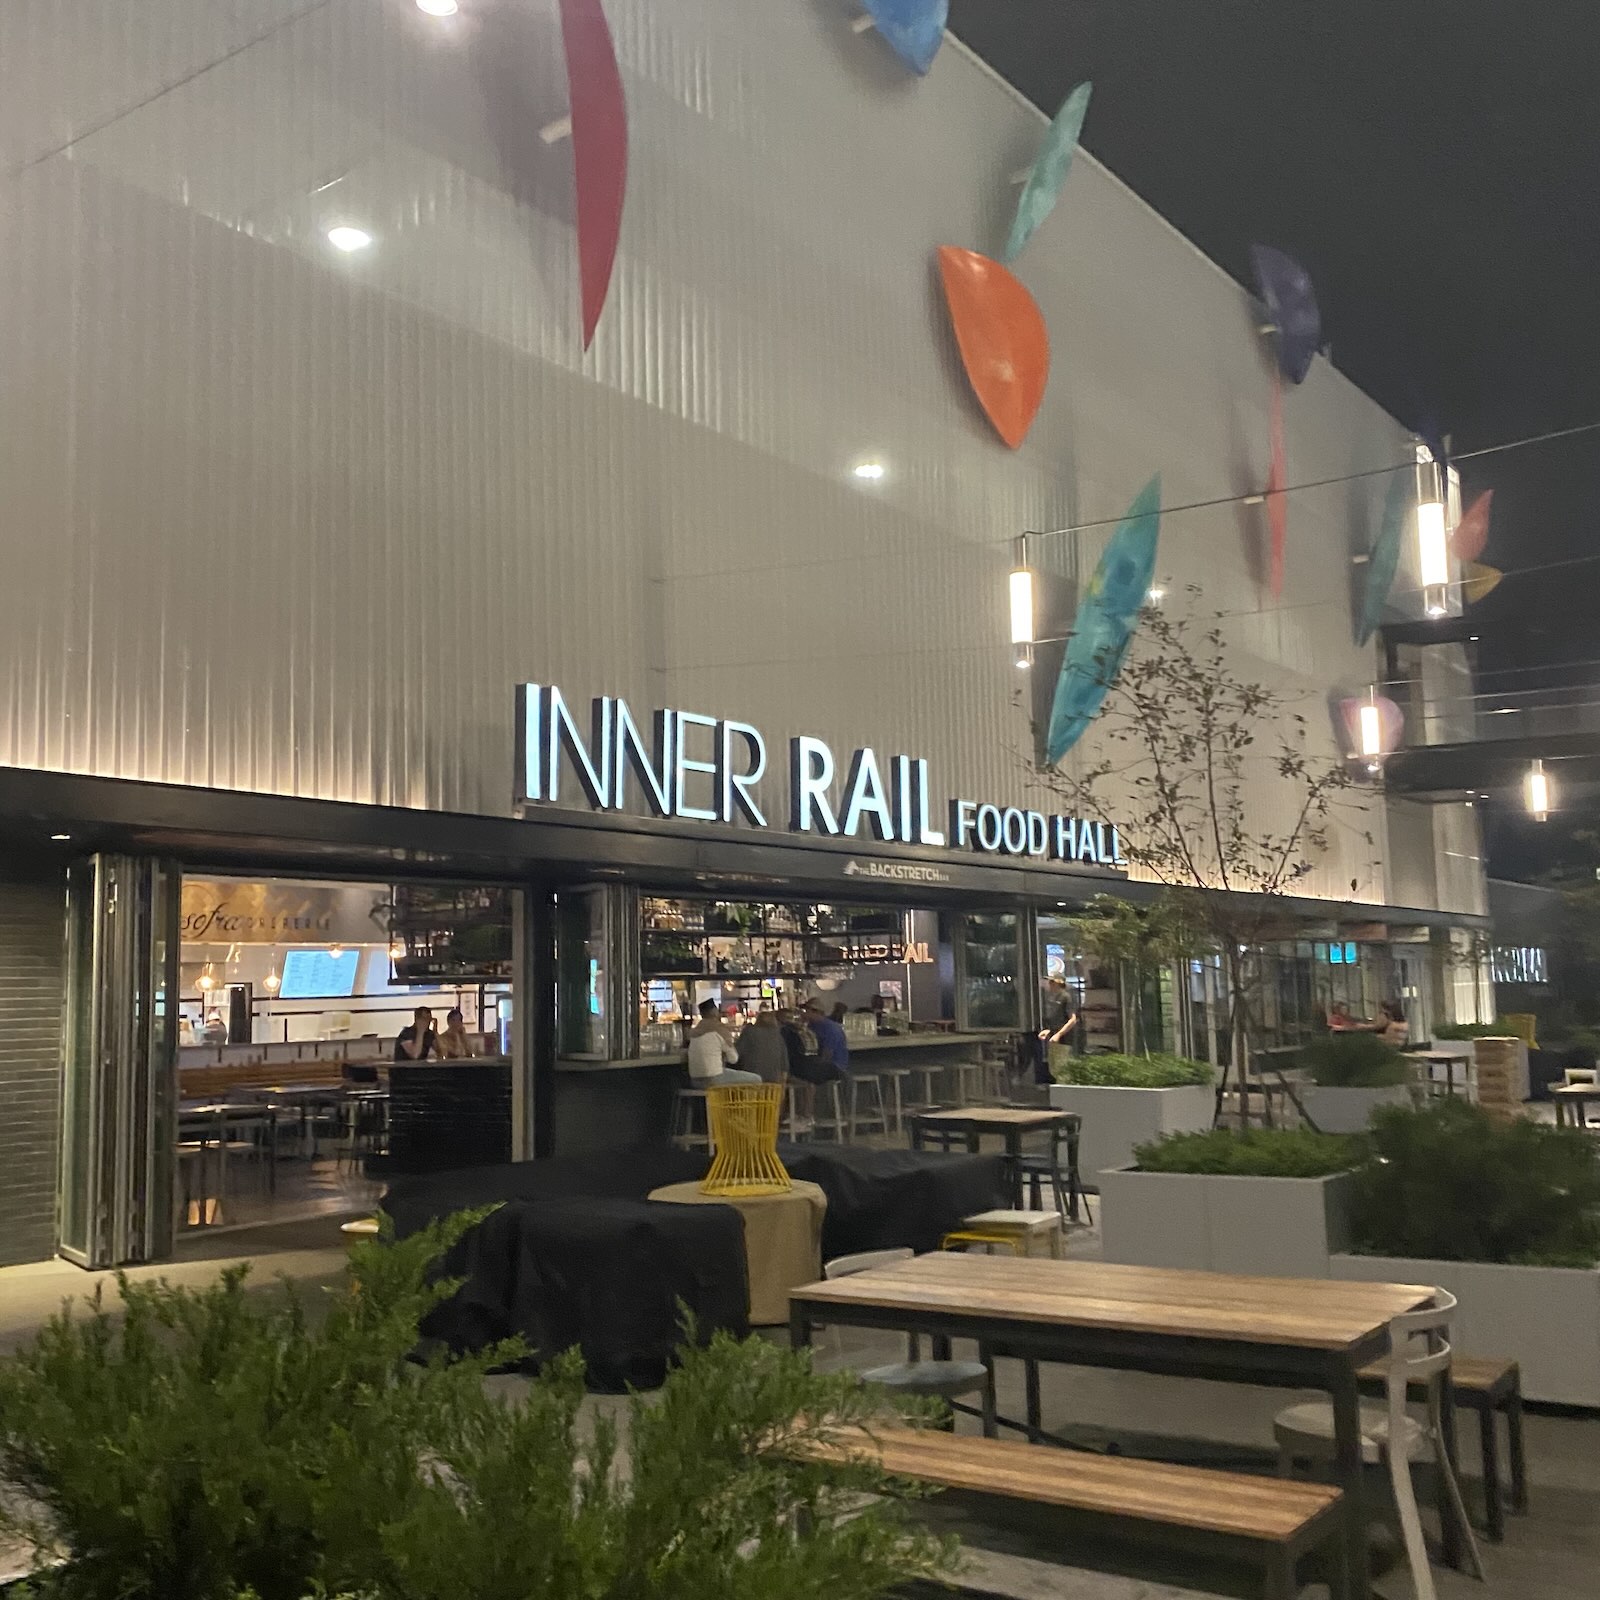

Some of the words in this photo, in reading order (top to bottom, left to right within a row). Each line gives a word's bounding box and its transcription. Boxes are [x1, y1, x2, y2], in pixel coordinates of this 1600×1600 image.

[524, 682, 768, 827] INNER
[798, 735, 945, 846] RAIL
[957, 801, 1047, 856] FOOD
[1056, 816, 1128, 865] HALL
[869, 862, 939, 881] BACKSTRETCH
